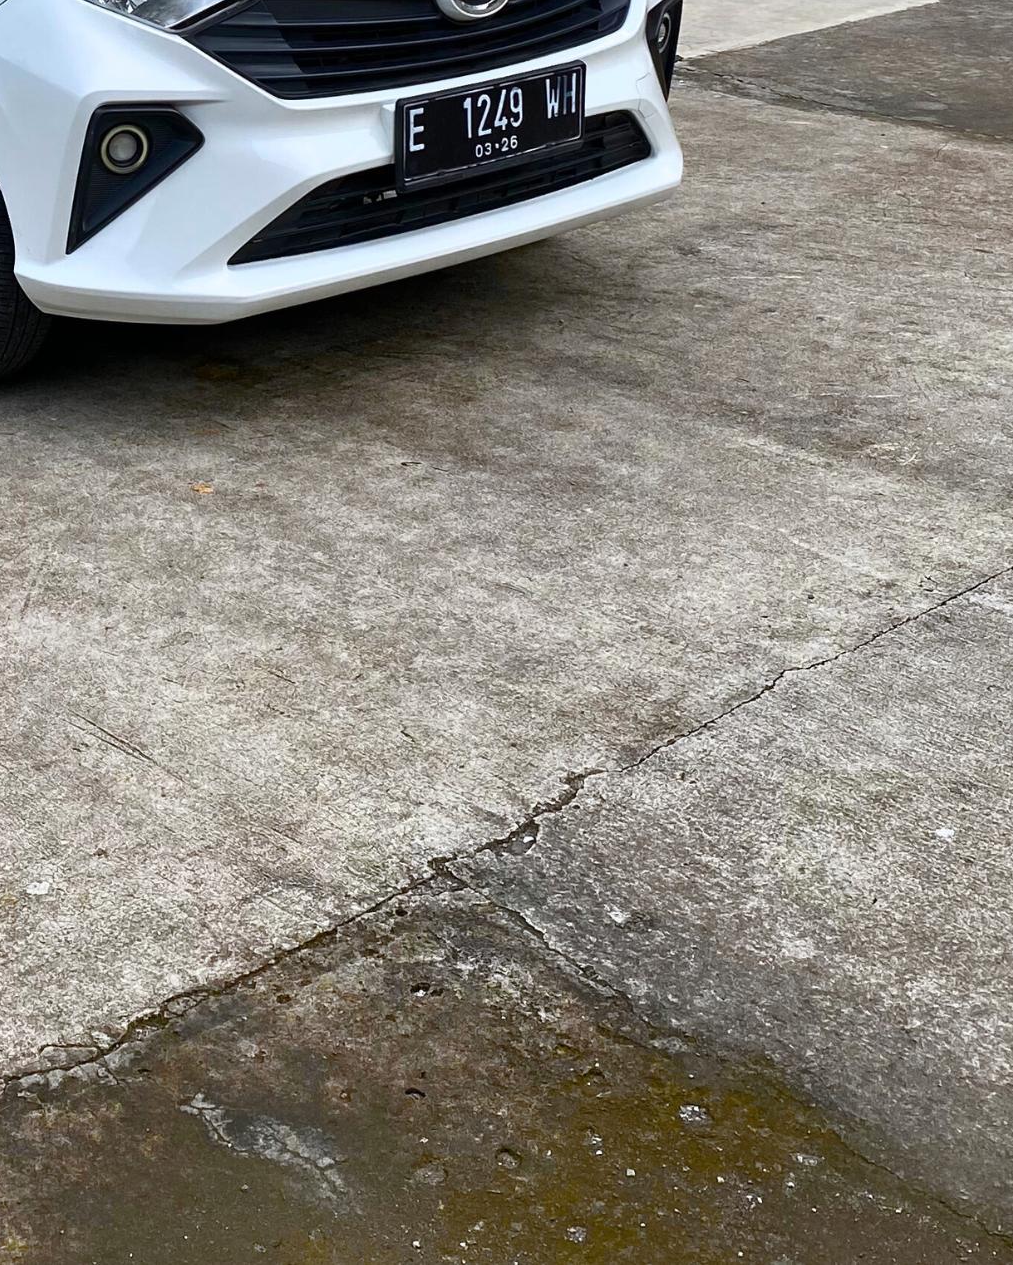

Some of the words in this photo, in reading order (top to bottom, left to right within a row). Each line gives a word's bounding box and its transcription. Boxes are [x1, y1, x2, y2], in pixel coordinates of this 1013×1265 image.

[409, 108, 425, 152] E
[463, 87, 523, 138] 1249
[545, 73, 577, 119] WH
